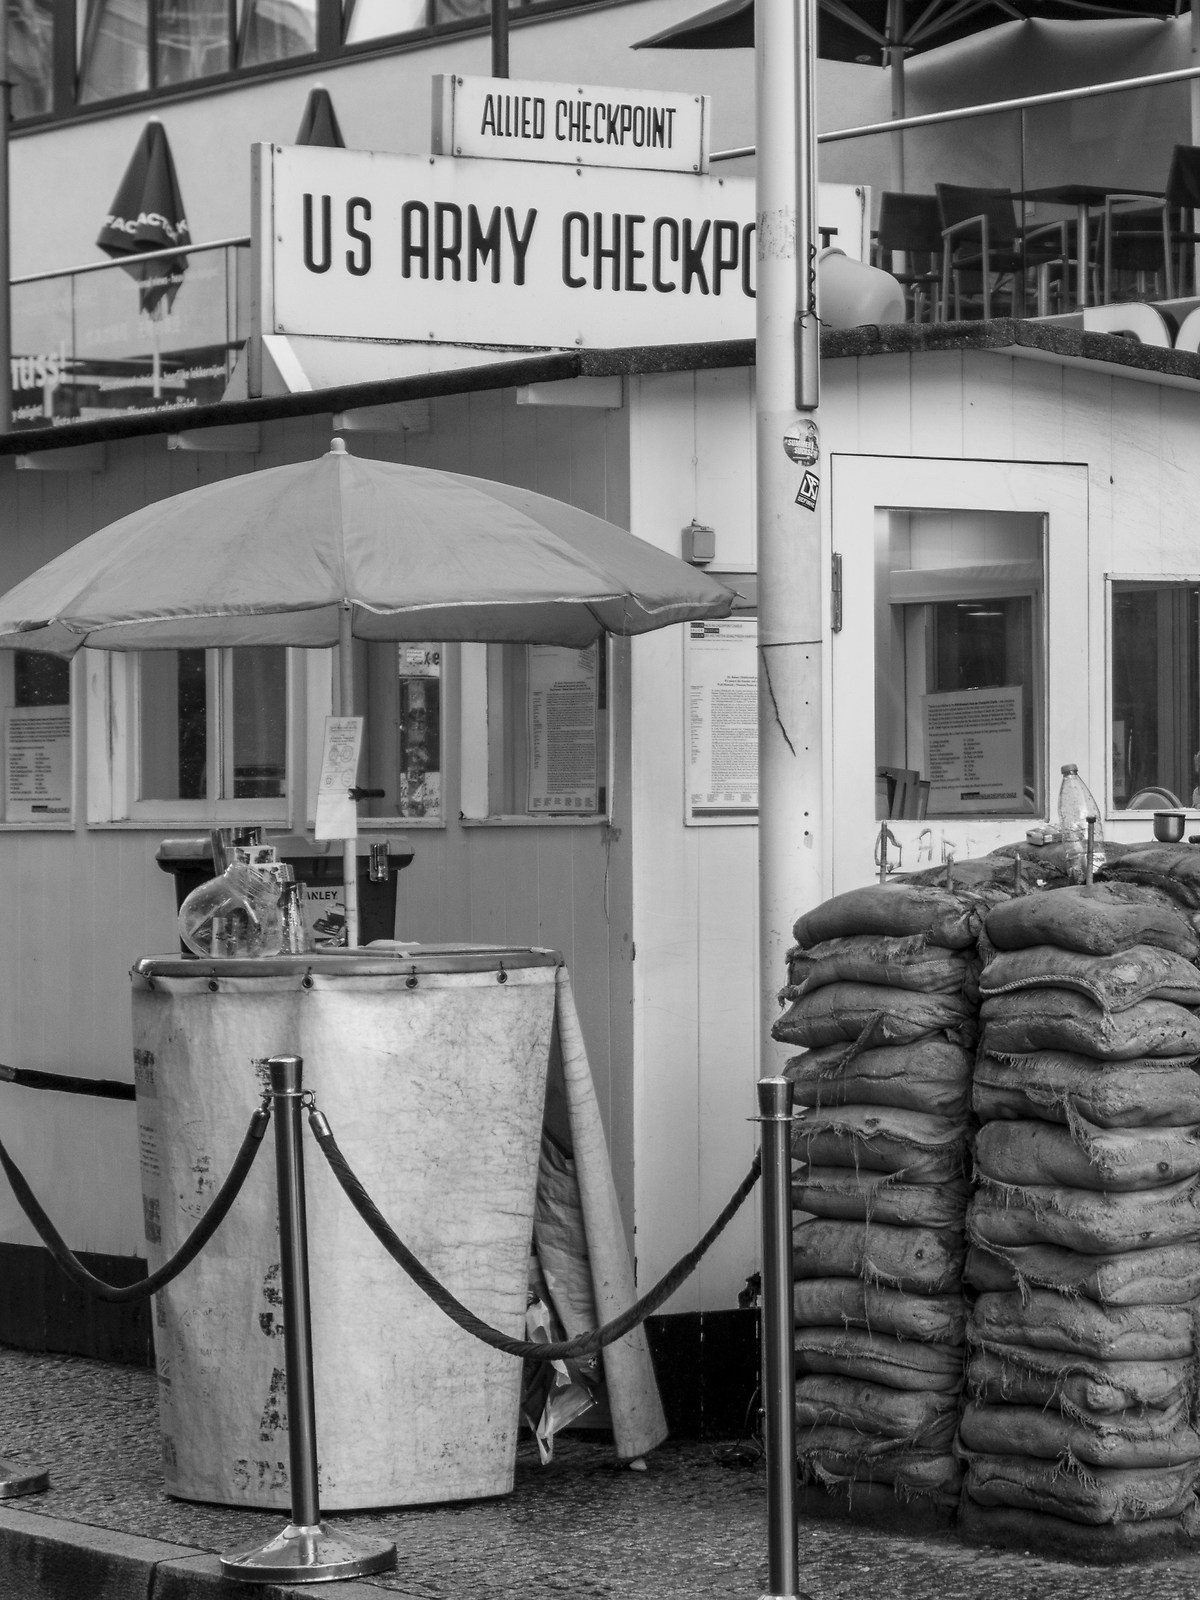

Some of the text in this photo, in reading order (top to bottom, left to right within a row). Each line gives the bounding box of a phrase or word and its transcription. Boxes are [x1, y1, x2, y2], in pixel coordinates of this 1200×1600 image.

[480, 93, 677, 149] ALLIED CHECKPOINT
[302, 192, 839, 299] US ARMY CHECKPOT
